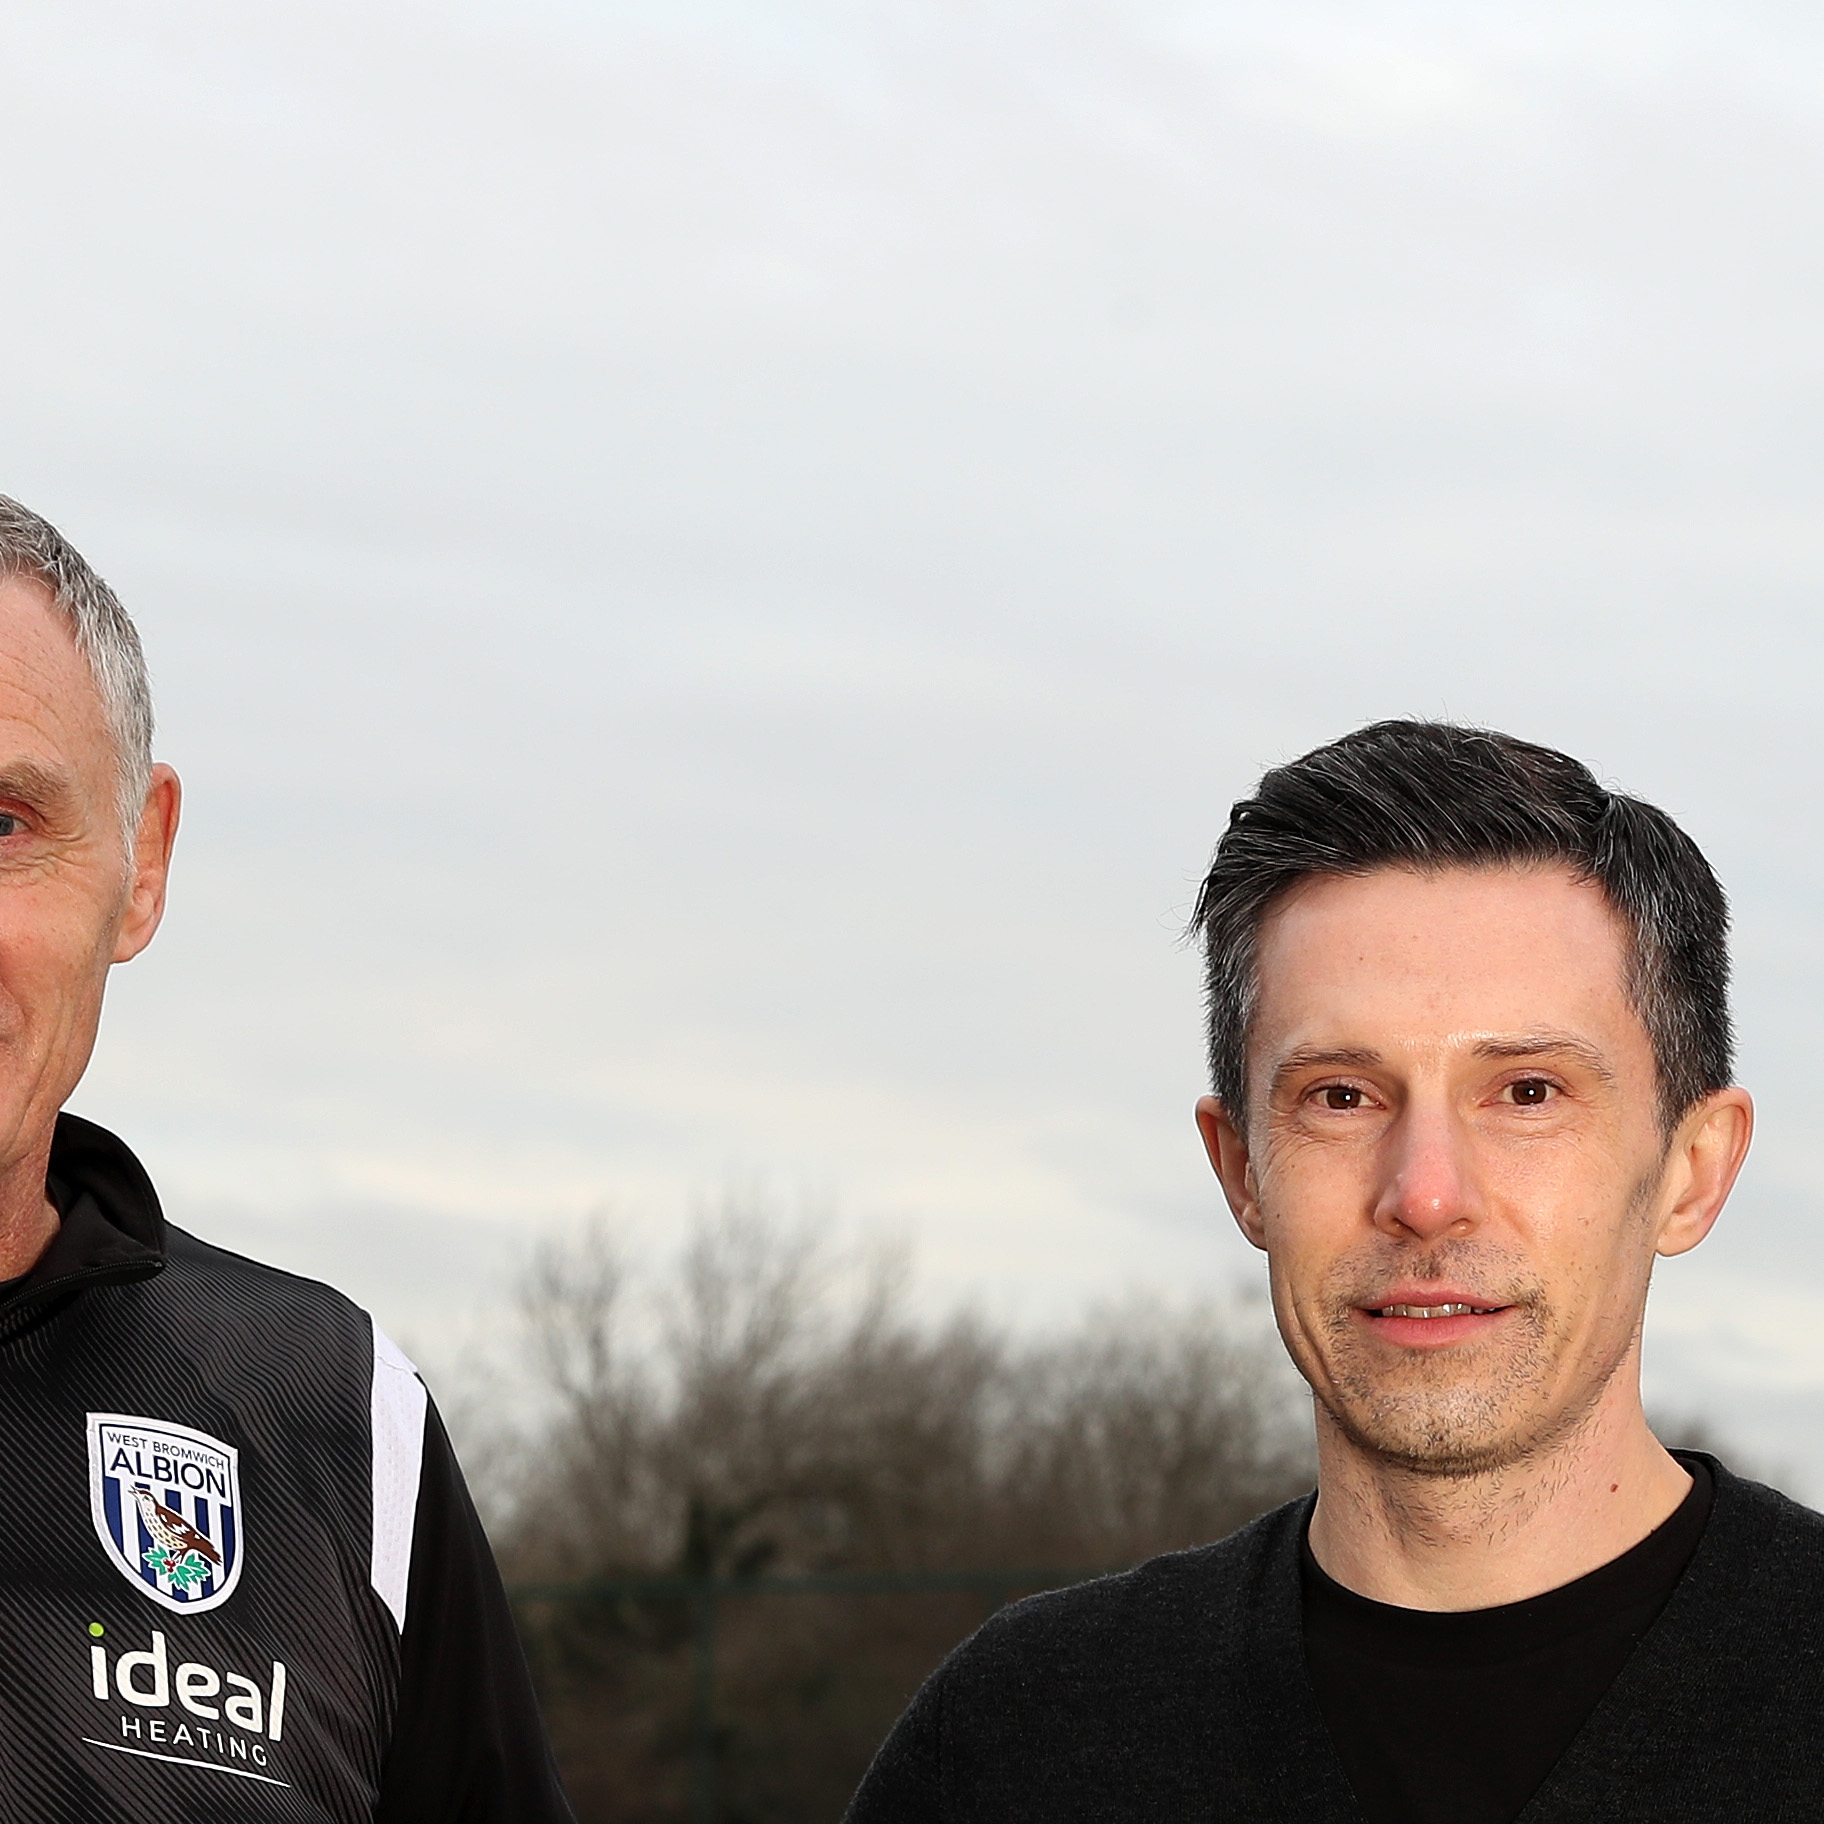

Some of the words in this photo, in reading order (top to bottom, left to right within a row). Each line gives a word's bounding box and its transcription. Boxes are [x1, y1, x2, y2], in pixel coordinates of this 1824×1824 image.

[106, 1431, 148, 1450] WEST
[153, 1440, 225, 1470] BROMWICH
[109, 1448, 226, 1499] ALBION
[88, 1622, 286, 1742] ideal
[121, 1715, 267, 1766] HEATING
